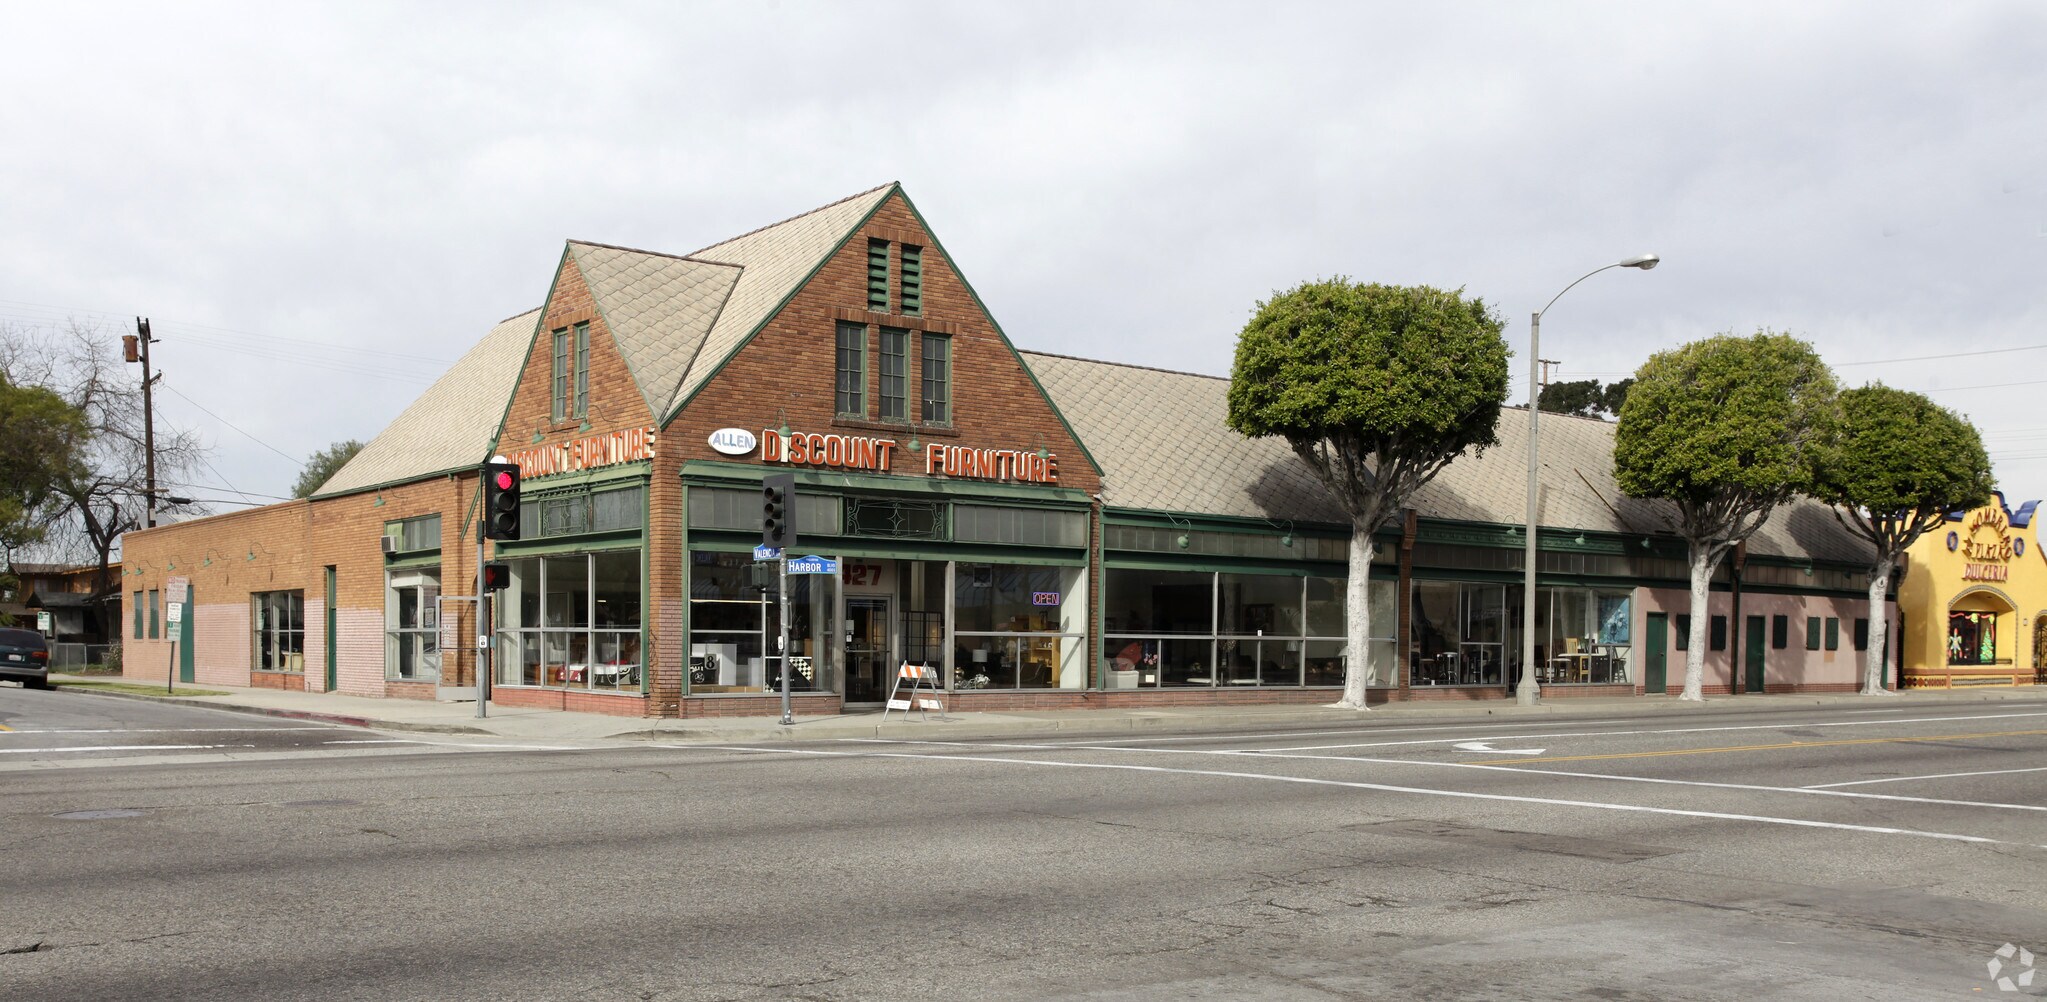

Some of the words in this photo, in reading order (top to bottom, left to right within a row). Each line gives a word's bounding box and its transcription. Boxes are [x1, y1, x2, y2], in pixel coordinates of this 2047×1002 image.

[572, 427, 654, 470] FURNITURE
[712, 432, 754, 449] ALLEN
[762, 428, 896, 471] DISCOUNT
[926, 443, 1057, 482] FURNITURE
[788, 561, 822, 572] HARBOR
[1963, 563, 2008, 581] DULCERIA
[1035, 593, 1058, 605] OPEN
[706, 655, 715, 669] 8
